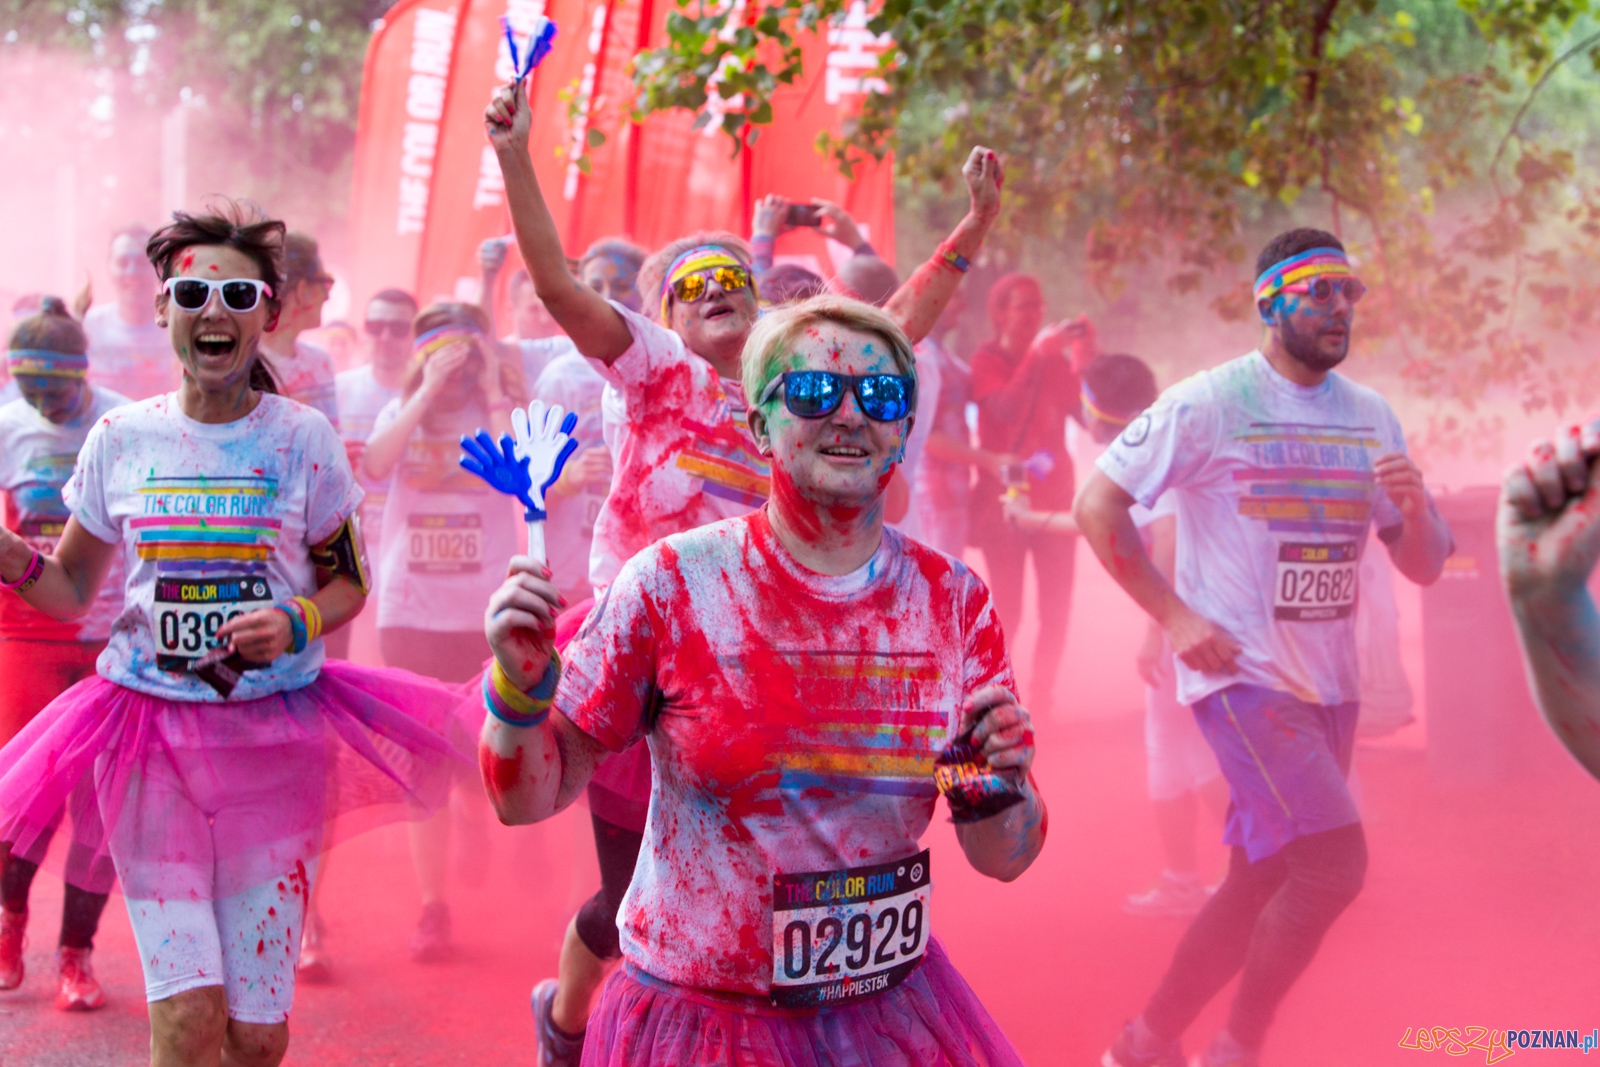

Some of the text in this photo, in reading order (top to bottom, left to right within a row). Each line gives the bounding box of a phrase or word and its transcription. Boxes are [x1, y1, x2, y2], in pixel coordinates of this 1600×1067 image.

[144, 494, 266, 516] THE COLOR RUN
[410, 532, 477, 558] 01026
[162, 584, 240, 600] THE COLOR RUN
[1281, 568, 1353, 602] 02682
[785, 871, 896, 903] THE COLOR RUN
[783, 899, 924, 980] 02929
[818, 972, 891, 1002] #HAPPIEST5K
